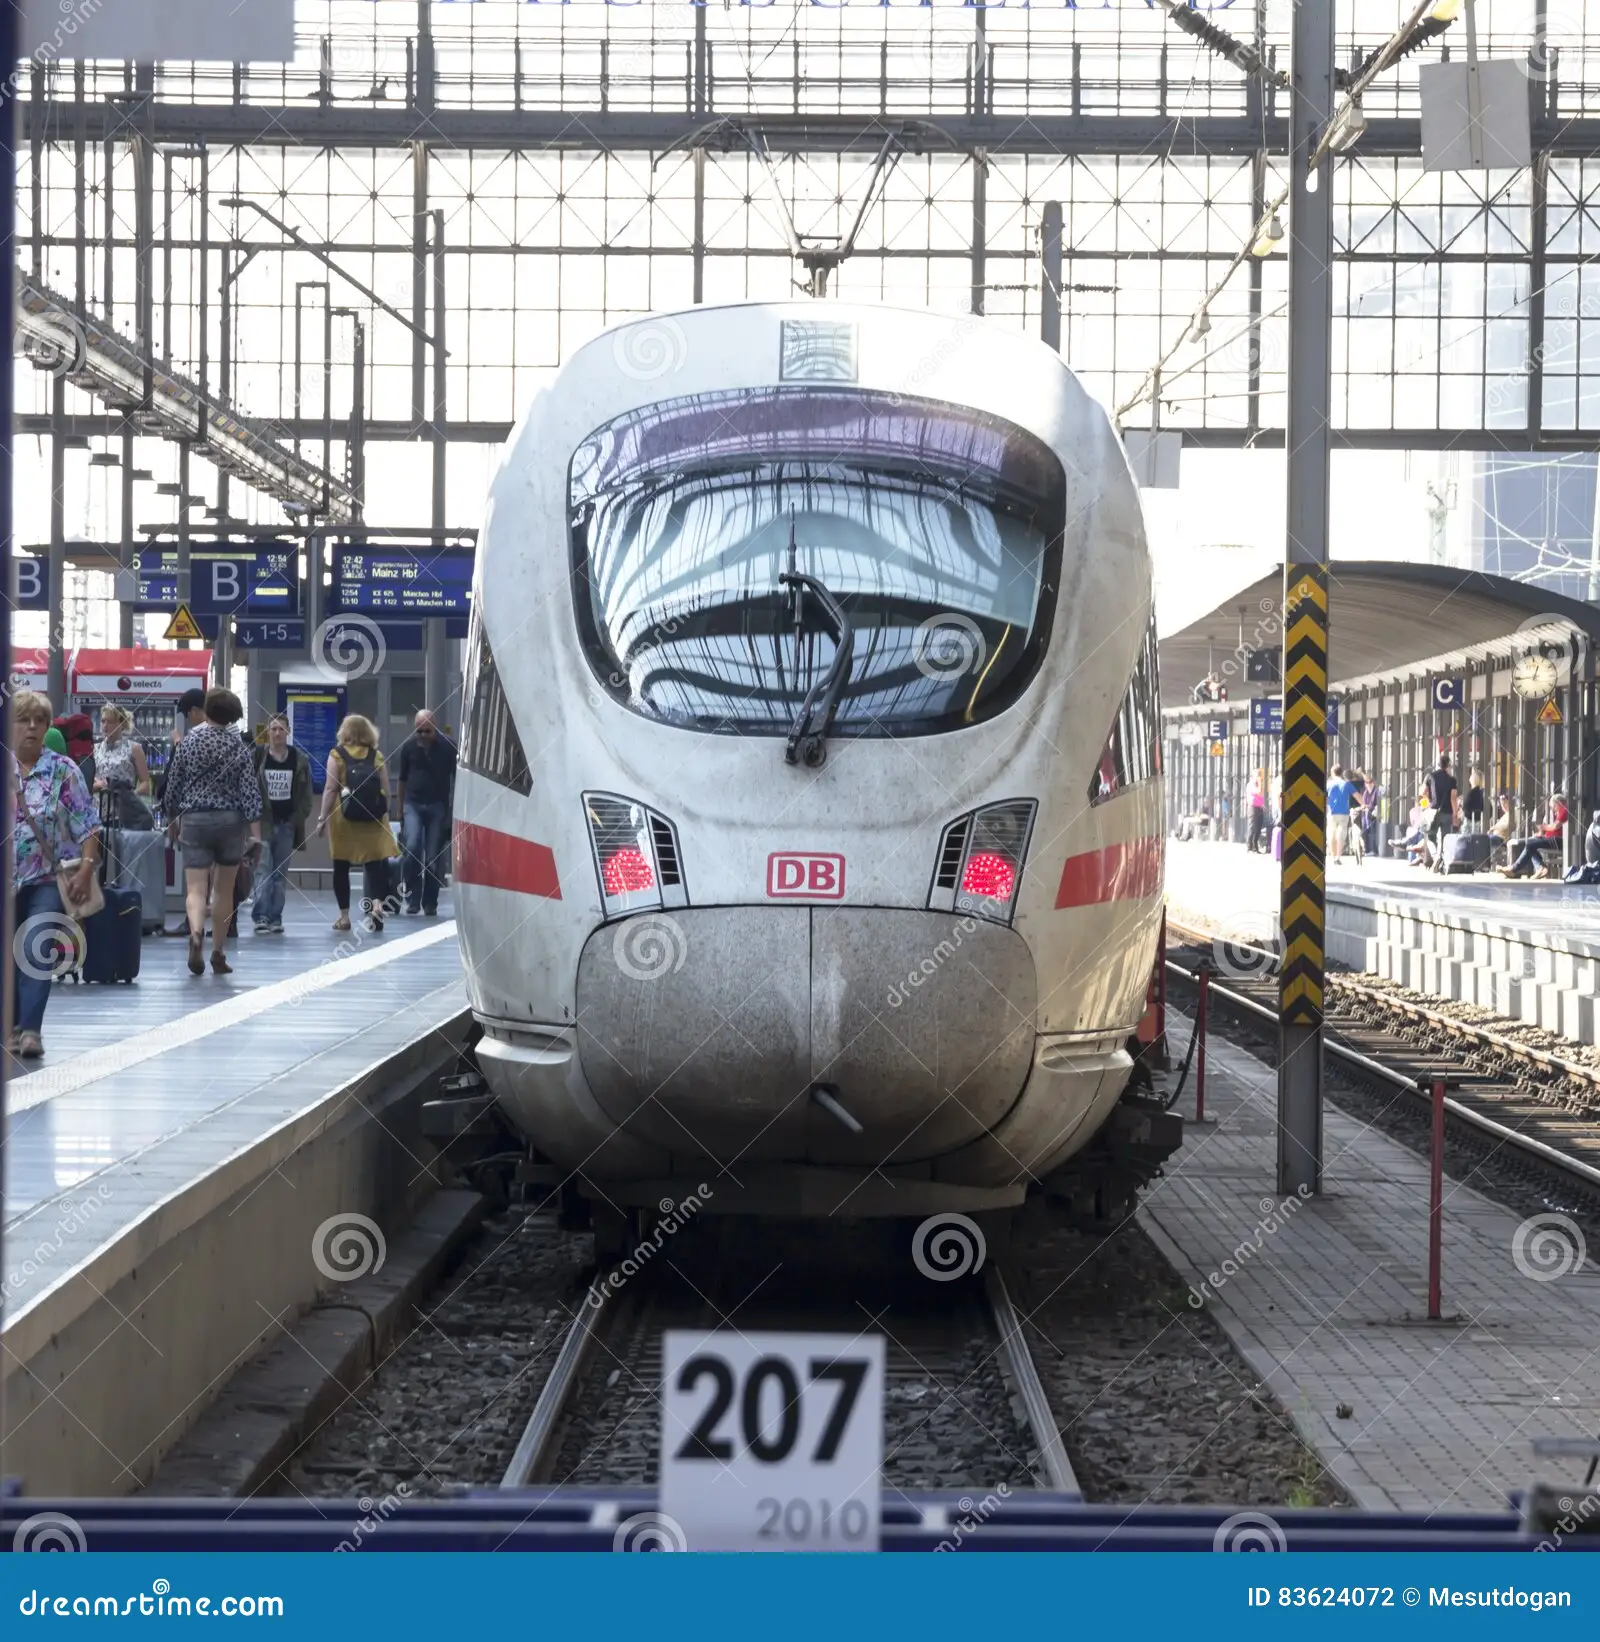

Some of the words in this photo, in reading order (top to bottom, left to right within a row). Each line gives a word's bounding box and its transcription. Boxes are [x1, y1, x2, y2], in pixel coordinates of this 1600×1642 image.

[267, 554, 287, 563] 12:54
[343, 556, 363, 564] 12:42
[17, 559, 41, 598] B
[212, 561, 240, 601] B
[372, 568, 398, 578] Mainz
[402, 568, 417, 578] Hbf
[261, 624, 287, 641] 1-5
[133, 678, 162, 689] selecta
[1436, 680, 1454, 703] C
[1209, 721, 1220, 737] E
[777, 859, 836, 890] DB
[672, 1353, 872, 1466] 207
[755, 1497, 869, 1542] 2010
